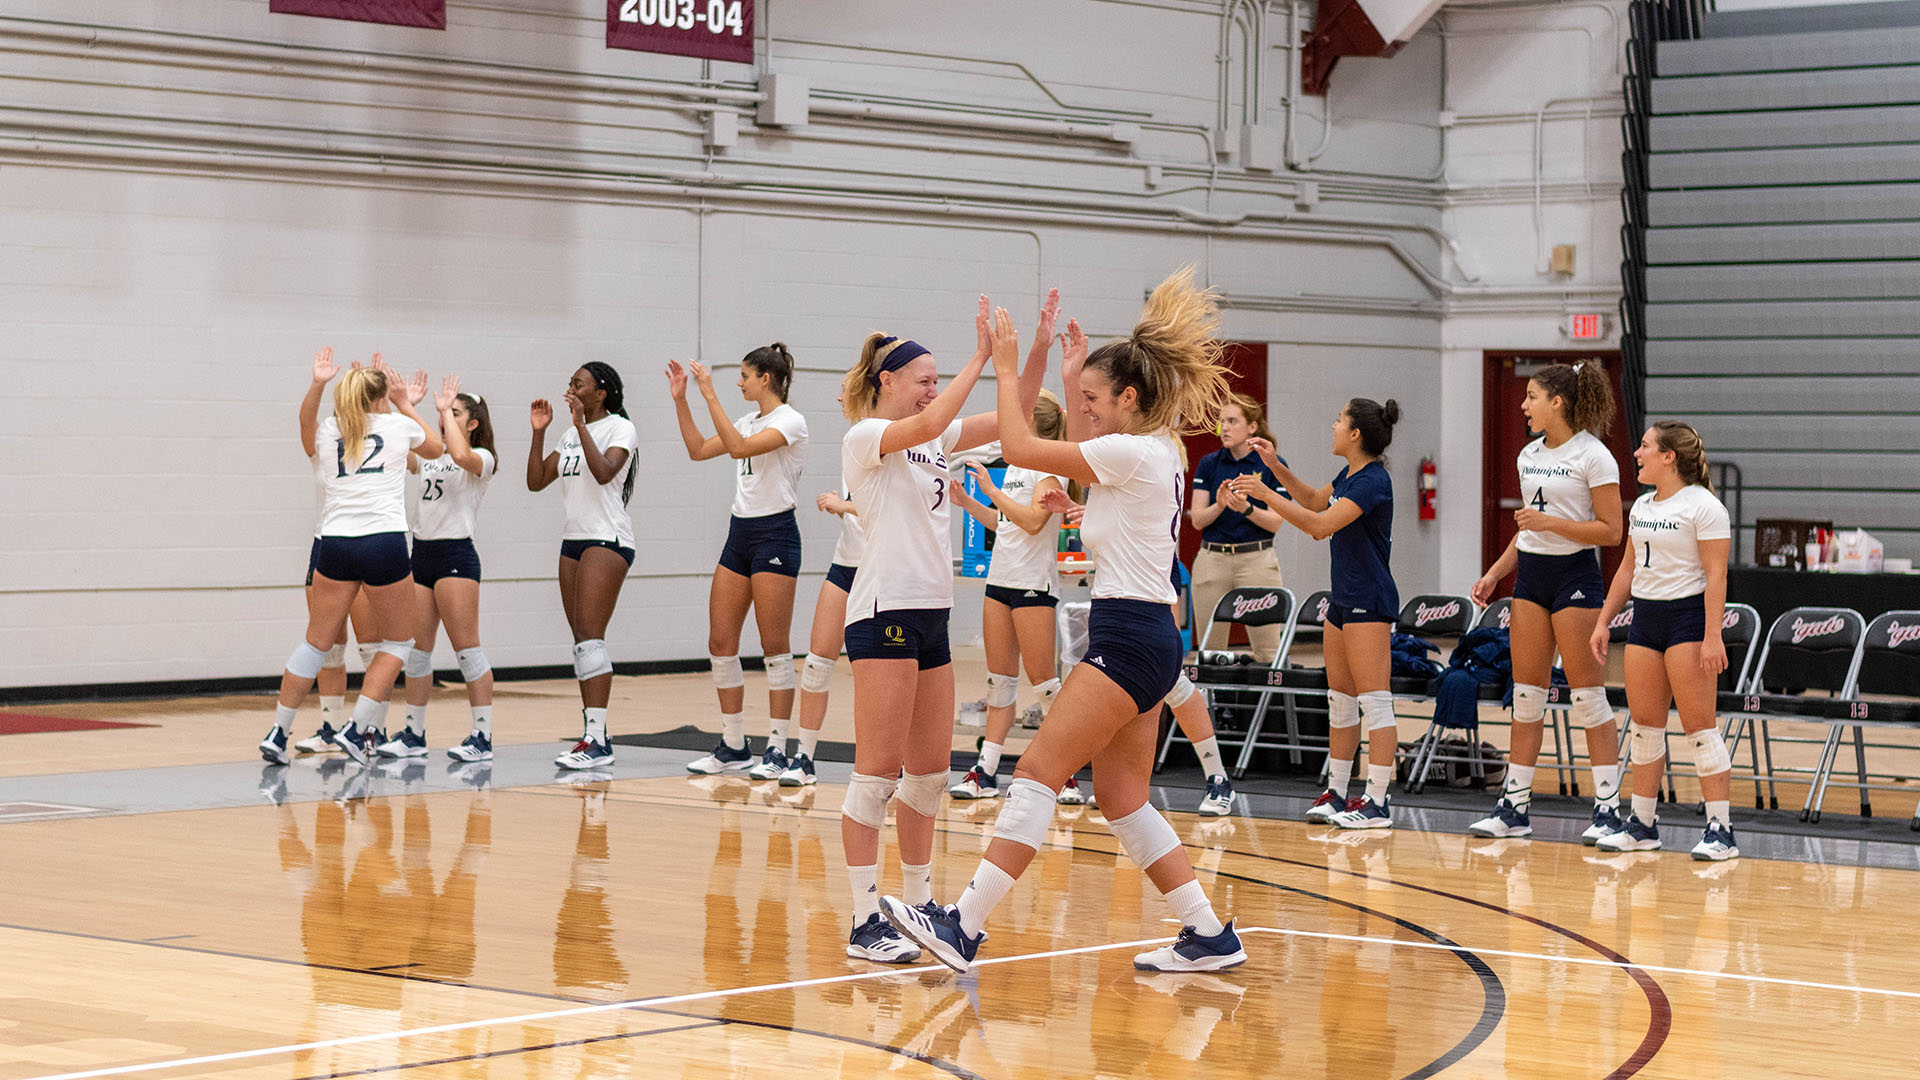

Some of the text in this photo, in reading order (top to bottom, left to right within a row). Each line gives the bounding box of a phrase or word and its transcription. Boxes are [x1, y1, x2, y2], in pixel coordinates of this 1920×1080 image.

[619, 0, 743, 36] 2003-04
[1573, 314, 1598, 337] EXIT
[335, 434, 384, 478] 12
[562, 455, 580, 477] 22
[422, 478, 444, 501] 25
[931, 477, 945, 511] 3
[1530, 486, 1548, 512] 4
[1643, 541, 1651, 568] 1
[885, 625, 906, 643] Q
[1267, 671, 1283, 685] 13
[1743, 696, 1761, 712] 13
[1850, 702, 1869, 719] 13
